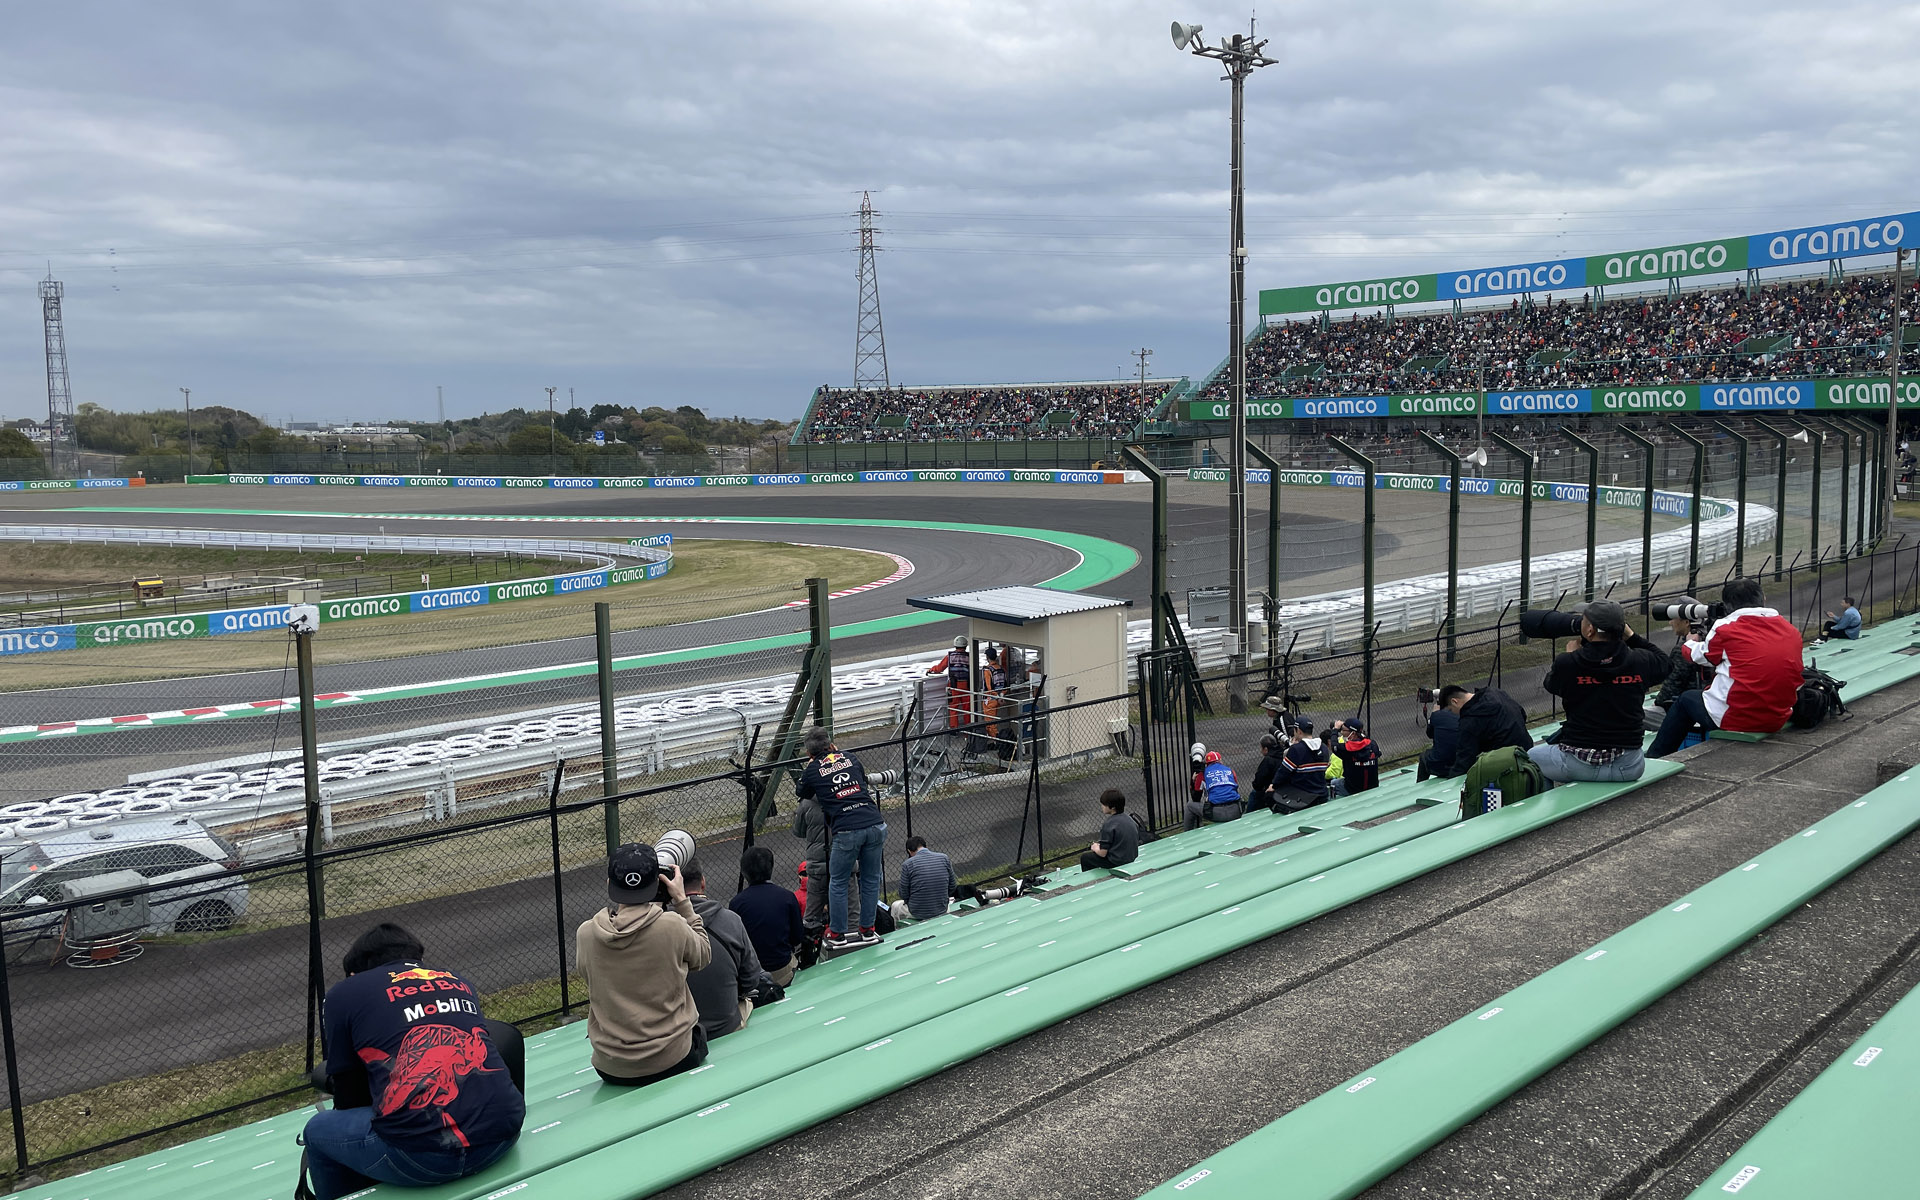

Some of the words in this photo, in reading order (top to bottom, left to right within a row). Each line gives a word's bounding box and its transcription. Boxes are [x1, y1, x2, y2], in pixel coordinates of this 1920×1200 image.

[1769, 220, 1904, 260] aramco
[1605, 244, 1728, 279] aramco
[1455, 264, 1567, 294] aramco
[1316, 279, 1420, 306] aramco
[1604, 389, 1687, 409] aramco
[1713, 385, 1801, 406] aramco
[1829, 382, 1920, 404] aramco
[1305, 399, 1377, 416] aramco
[1400, 396, 1476, 413] aramco
[1500, 393, 1579, 411] aramco
[1212, 402, 1283, 417] armco
[229, 475, 264, 485] aramco
[273, 475, 311, 485] aramco
[319, 476, 355, 486] aramco
[364, 476, 400, 486] aramco
[410, 477, 448, 487] aramco
[457, 477, 496, 487] aramco
[654, 477, 695, 487] aramco
[705, 475, 748, 486] aramco
[758, 474, 800, 484] aramco
[811, 473, 854, 483] aramco
[865, 471, 908, 481] aramco
[918, 471, 957, 481] aramco
[966, 471, 1005, 481] aramco
[1013, 471, 1051, 482] aramco
[1060, 472, 1098, 483] aramco
[1193, 470, 1225, 481] aramco
[1246, 472, 1270, 482] amco
[1280, 472, 1323, 484] aramco
[1336, 474, 1377, 487] aram
[30, 480, 71, 489] aramco
[83, 479, 123, 487] aramco
[505, 478, 543, 488] aramco
[554, 478, 593, 488] aramco
[603, 478, 644, 488] aramco
[1389, 476, 1434, 490] aramco
[1445, 479, 1489, 493] aamco
[1500, 482, 1545, 497] araco
[1555, 486, 1590, 501] aramc
[1606, 490, 1642, 507] aramco
[631, 535, 670, 547] aramco
[612, 568, 644, 583] aramco
[561, 574, 602, 591] aramco
[497, 581, 547, 599] aramco
[421, 589, 481, 608] aramco
[329, 597, 400, 619] aramco
[223, 609, 290, 630] aramc
[94, 619, 195, 642] aramco
[0, 630, 59, 651] mco
[838, 786, 860, 797] TOTAL
[386, 980, 436, 1003] Red
[434, 980, 473, 996] Bull
[403, 998, 461, 1022] Mobil
